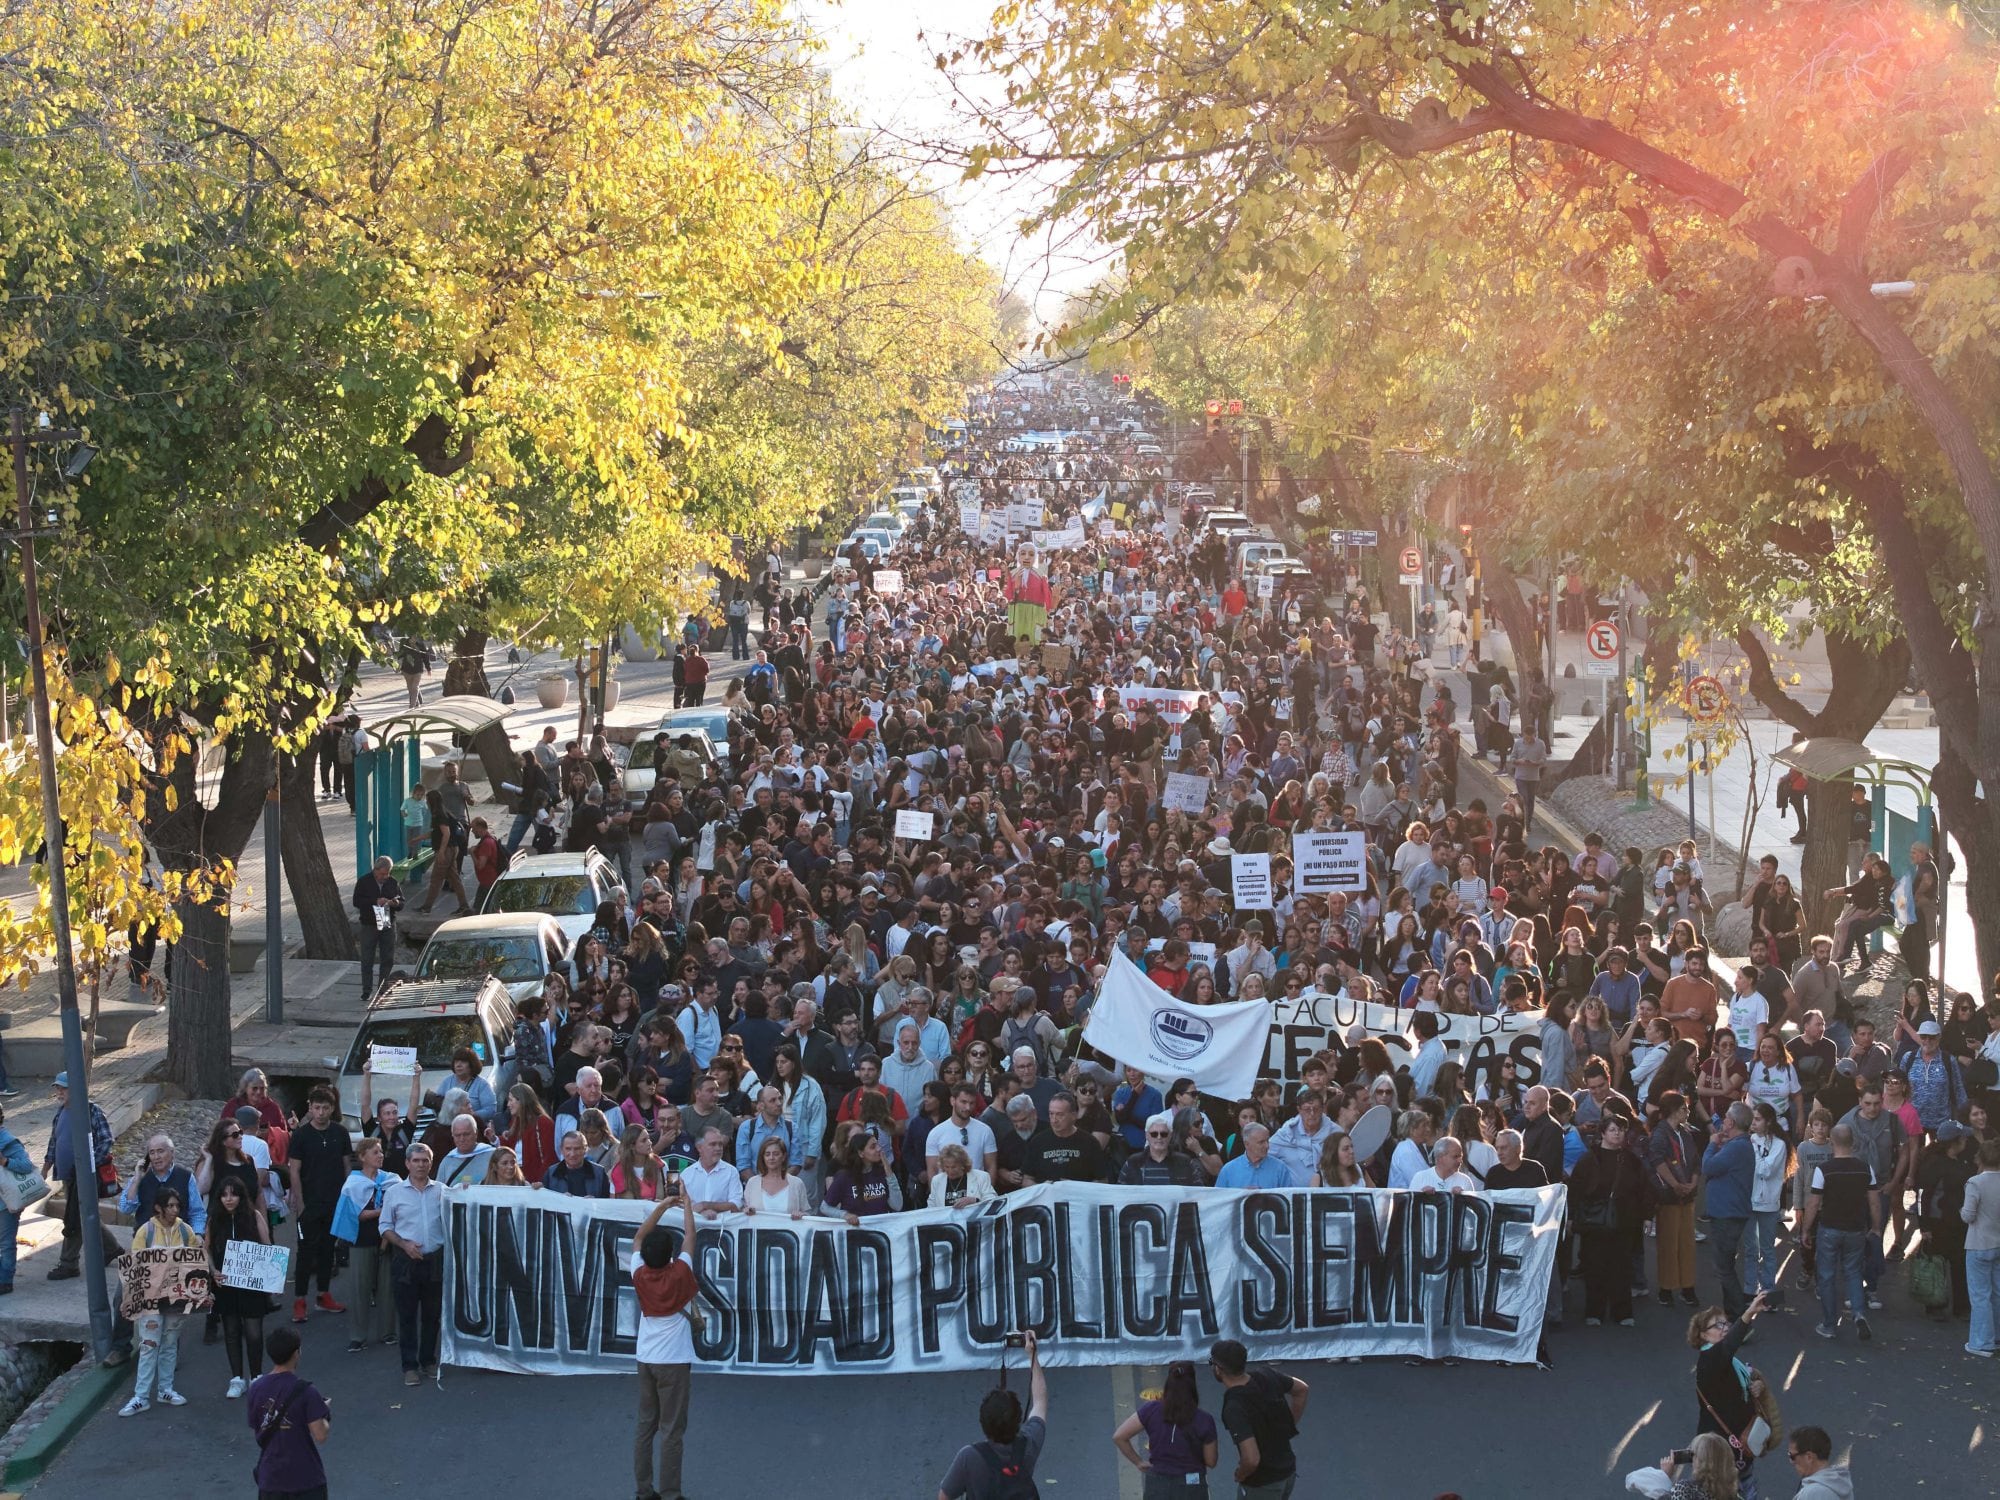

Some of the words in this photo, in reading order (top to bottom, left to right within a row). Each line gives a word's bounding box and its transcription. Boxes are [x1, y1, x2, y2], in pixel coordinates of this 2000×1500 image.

[1598, 631, 1610, 651] E
[1312, 838, 1348, 846] UNIVERSIDAD
[1313, 861, 1321, 869] UN
[1323, 861, 1337, 869] PASO
[1479, 1012, 1519, 1035] DE
[18, 1178, 37, 1194] puro
[852, 1182, 886, 1192] FANJA
[236, 1253, 250, 1261] TAN
[246, 1243, 285, 1257] LIBERTAD
[118, 1255, 132, 1271] NO
[135, 1249, 168, 1264] SOMOS
[172, 1248, 205, 1262] CASTA
[223, 1258, 233, 1267] NO
[123, 1266, 151, 1283] SOMOS
[452, 1203, 894, 1364] UNIVESIDAD
[917, 1198, 1219, 1353] PÚBLICA
[1242, 1191, 1535, 1334] SIEMPRE
[129, 1279, 151, 1294] PIBES
[132, 1289, 145, 1302] CON
